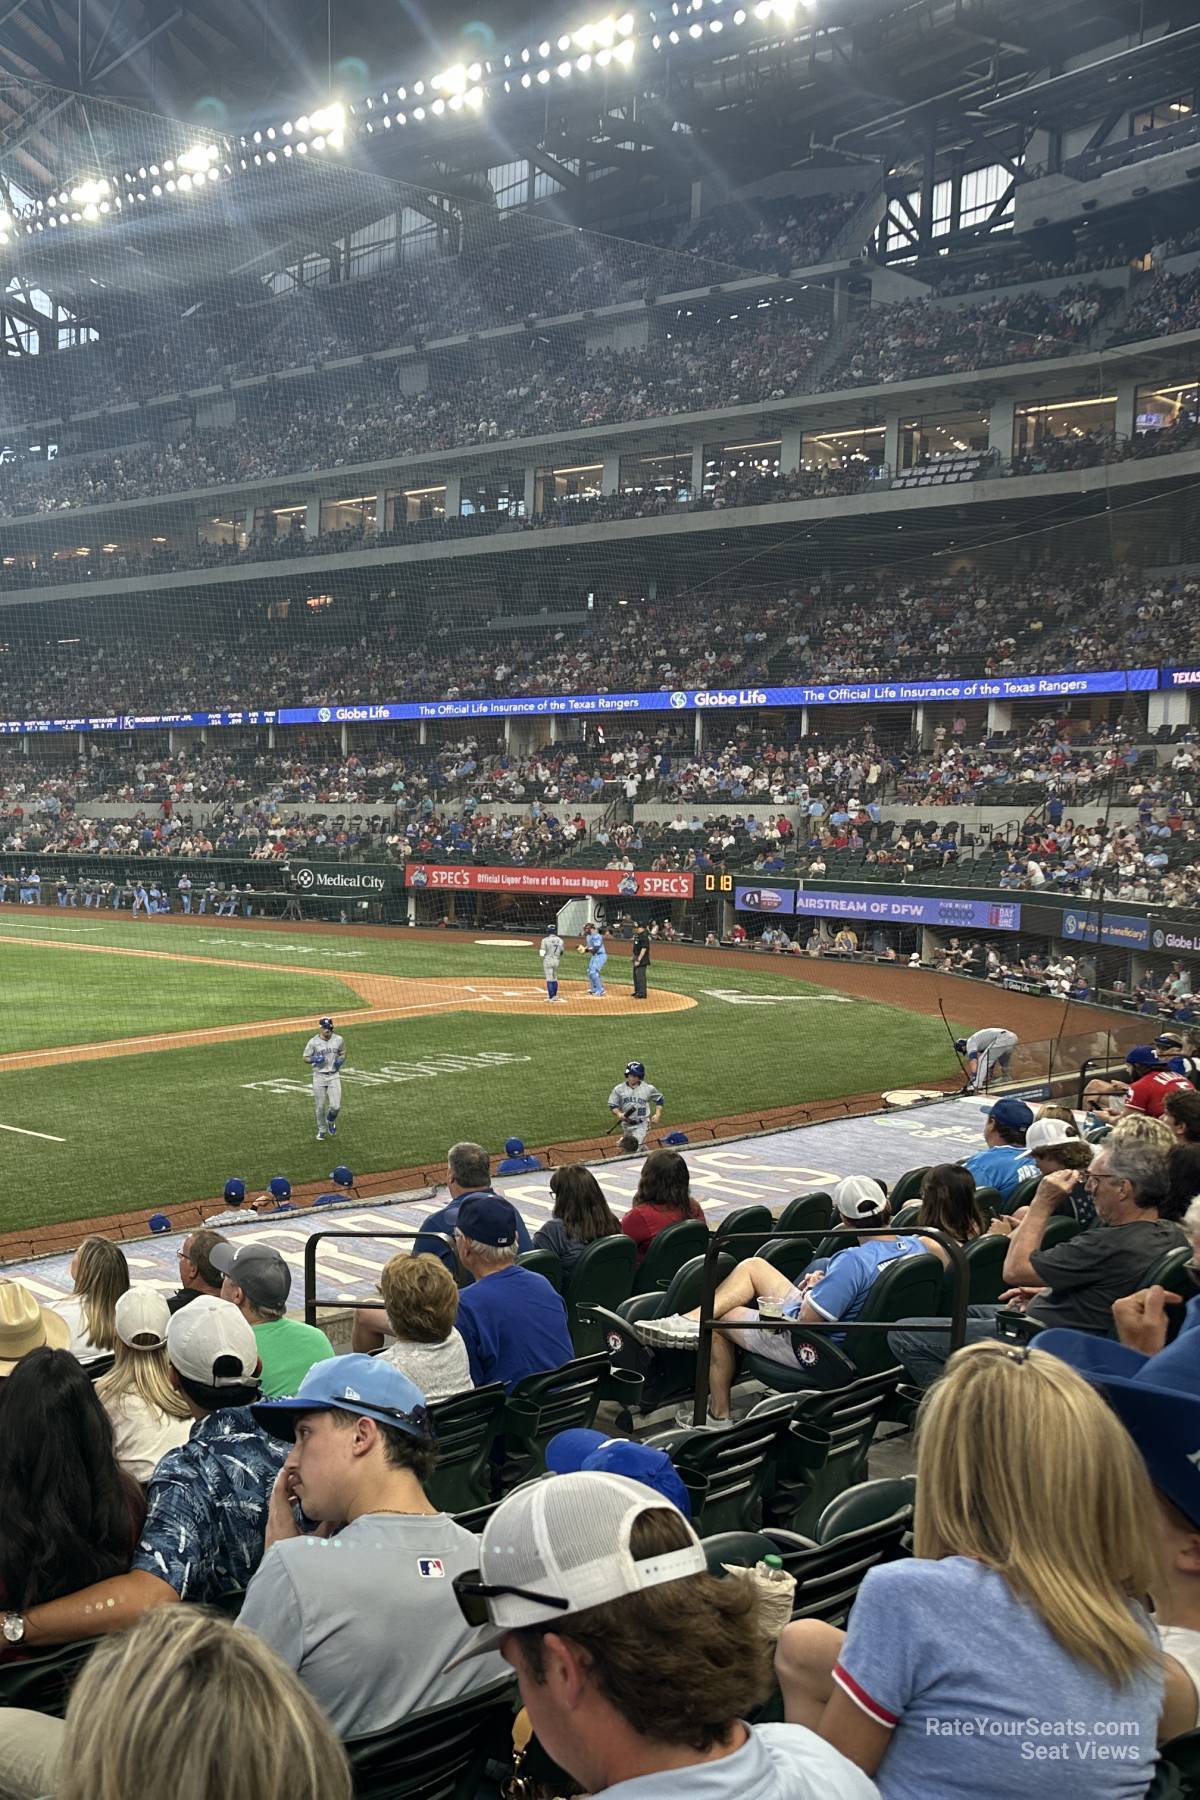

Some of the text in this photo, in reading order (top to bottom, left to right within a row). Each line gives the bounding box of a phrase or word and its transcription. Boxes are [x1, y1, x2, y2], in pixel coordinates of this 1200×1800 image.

[694, 690, 766, 706] Globe Life
[803, 680, 1087, 701] The Official Life Insurance of the Texas Rangers
[336, 706, 390, 720] Globe Life
[419, 698, 639, 715] The Official Life Insurance of the Texas Rangers
[316, 873, 385, 891] Medical City
[432, 870, 689, 893] SPEC'S Official Liquor Store of the Texas Rangers SPEC'S
[720, 875, 733, 891] 18
[797, 897, 924, 916] AIRSTREAM OF DFW
[999, 908, 1014, 917] DAY
[1110, 926, 1147, 941] beneficiary?
[1166, 933, 1192, 949] Globe
[553, 944, 559, 954] 7
